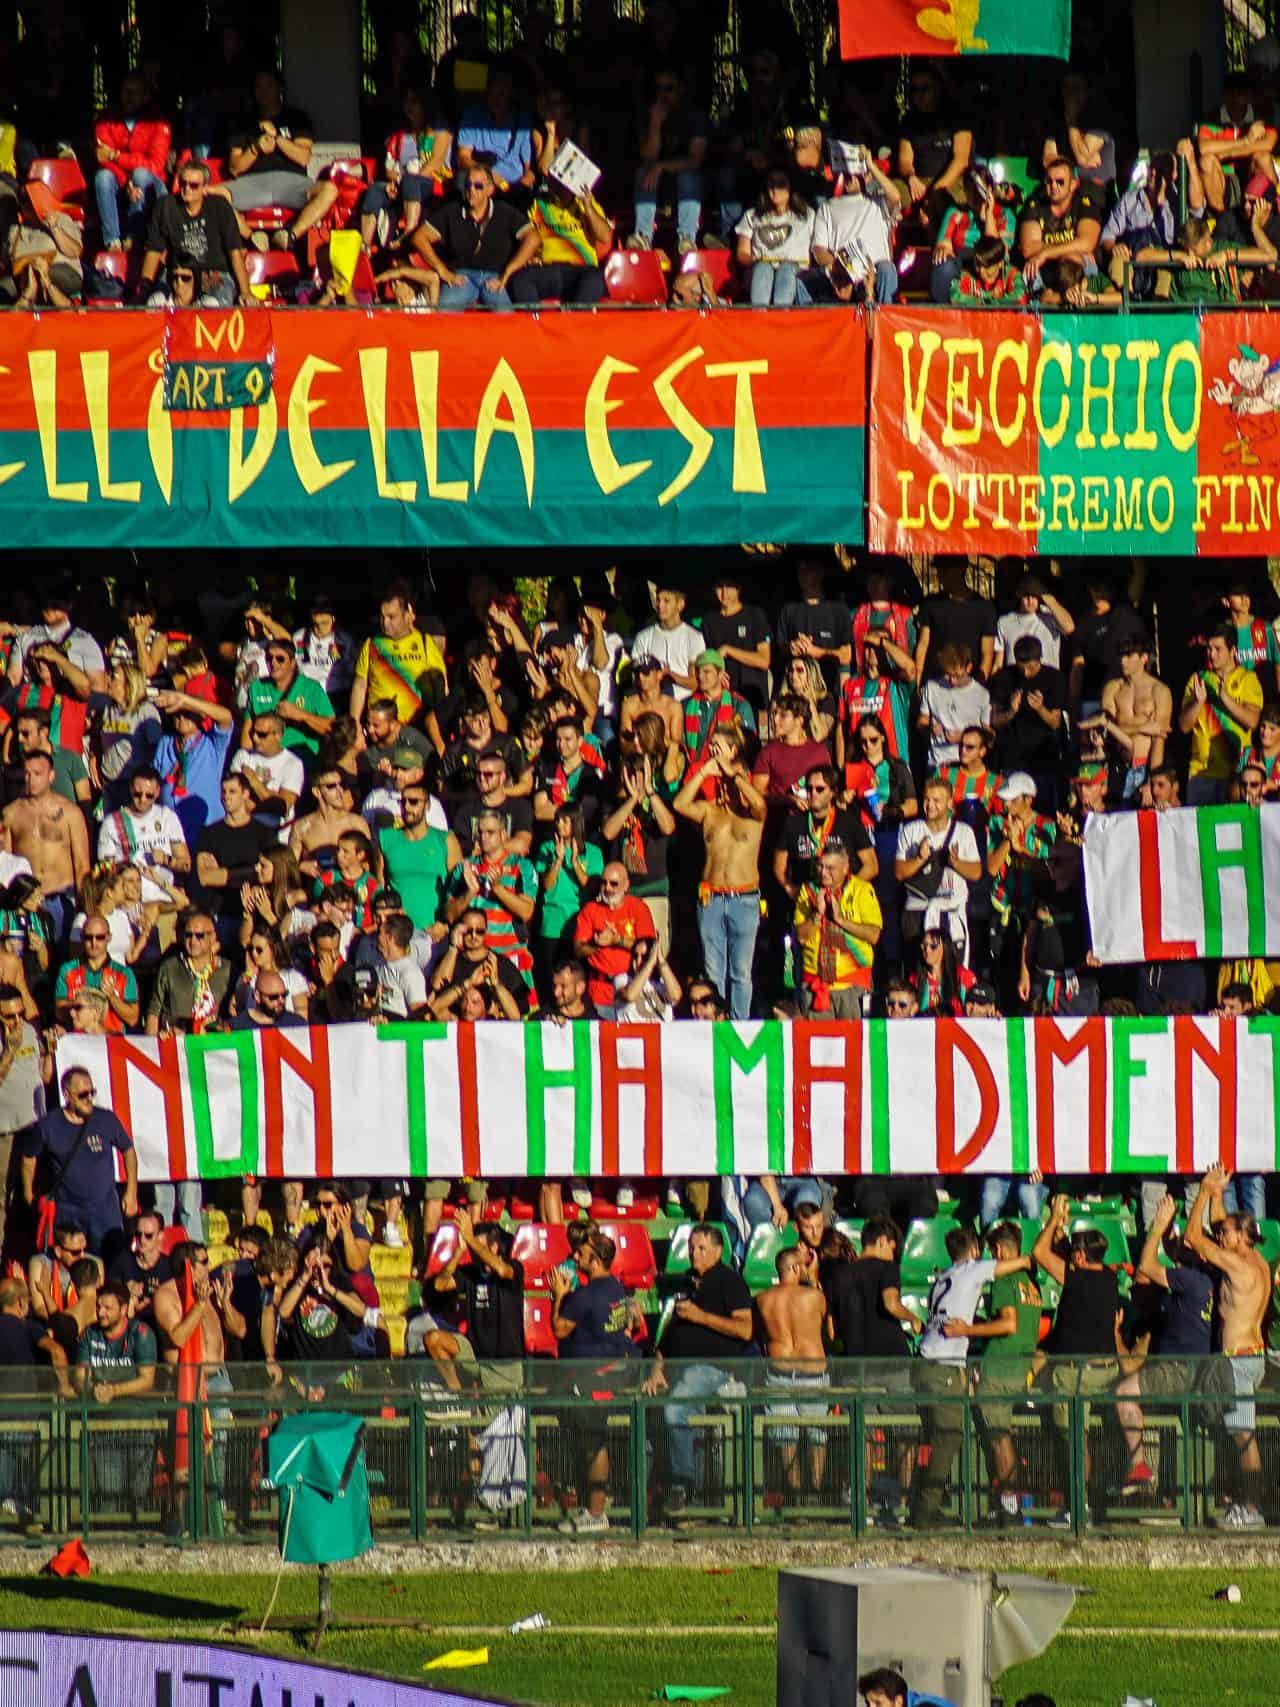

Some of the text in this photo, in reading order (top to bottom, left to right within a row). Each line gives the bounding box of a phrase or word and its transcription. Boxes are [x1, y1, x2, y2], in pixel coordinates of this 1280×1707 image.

[172, 367, 264, 409] ART. 9
[195, 309, 245, 352] NO
[0, 345, 769, 510] LLI DELLA EST
[894, 331, 1203, 453] VECCHIO
[896, 470, 1175, 533] LOTTEREMO
[1137, 802, 1265, 960] LA
[105, 1024, 333, 1179] NON
[377, 1020, 481, 1178] TI
[524, 1020, 663, 1177] HA
[713, 1018, 891, 1176] MAI
